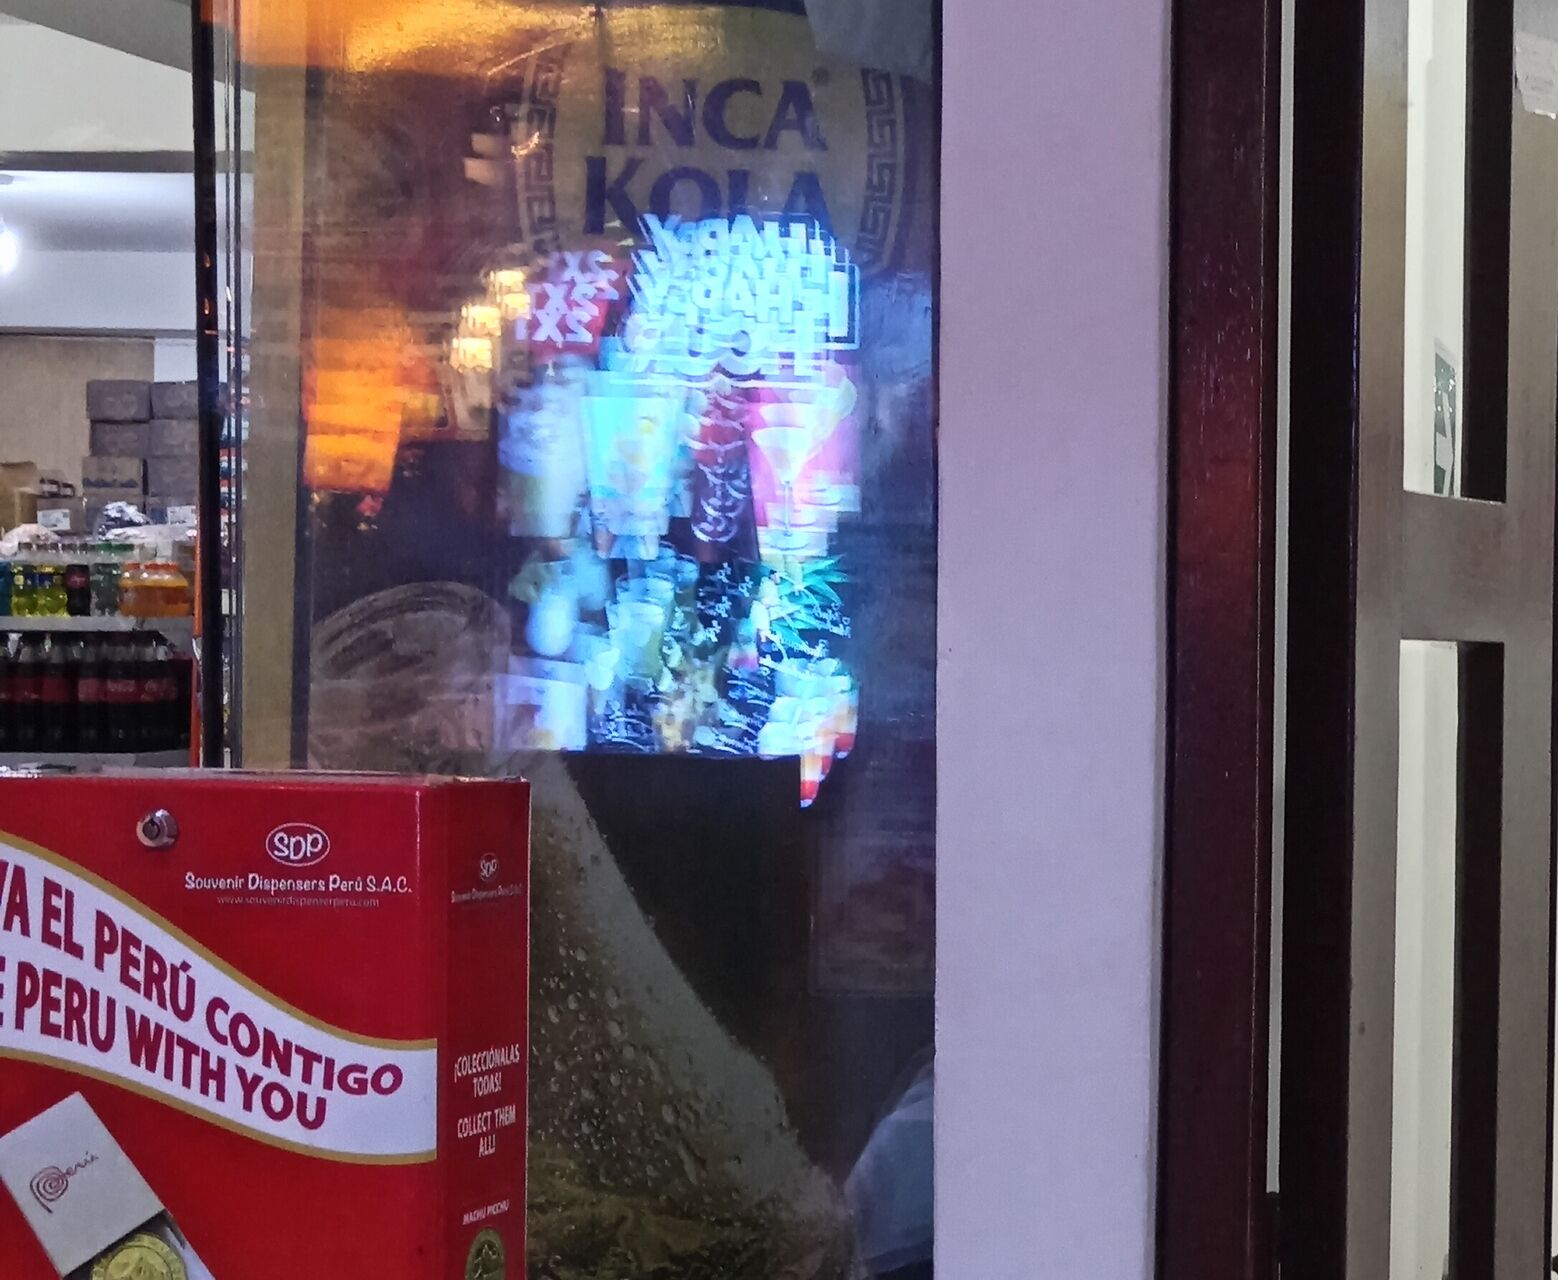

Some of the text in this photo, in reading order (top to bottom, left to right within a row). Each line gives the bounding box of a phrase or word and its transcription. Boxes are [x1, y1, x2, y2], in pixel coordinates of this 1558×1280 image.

[602, 67, 828, 151] INCA
[273, 831, 323, 860] SDP
[185, 872, 244, 890] Souvenir
[248, 872, 326, 896] Dispensers
[366, 875, 413, 893] S.A.C.
[41, 876, 84, 960] EL
[94, 910, 196, 1023] PERÚ
[205, 996, 403, 1096] CONTIGO
[15, 960, 116, 1053] PERU
[125, 1005, 226, 1103] WITH
[236, 1064, 327, 1130] YOU
[457, 1104, 516, 1139] COLLECT THEM
